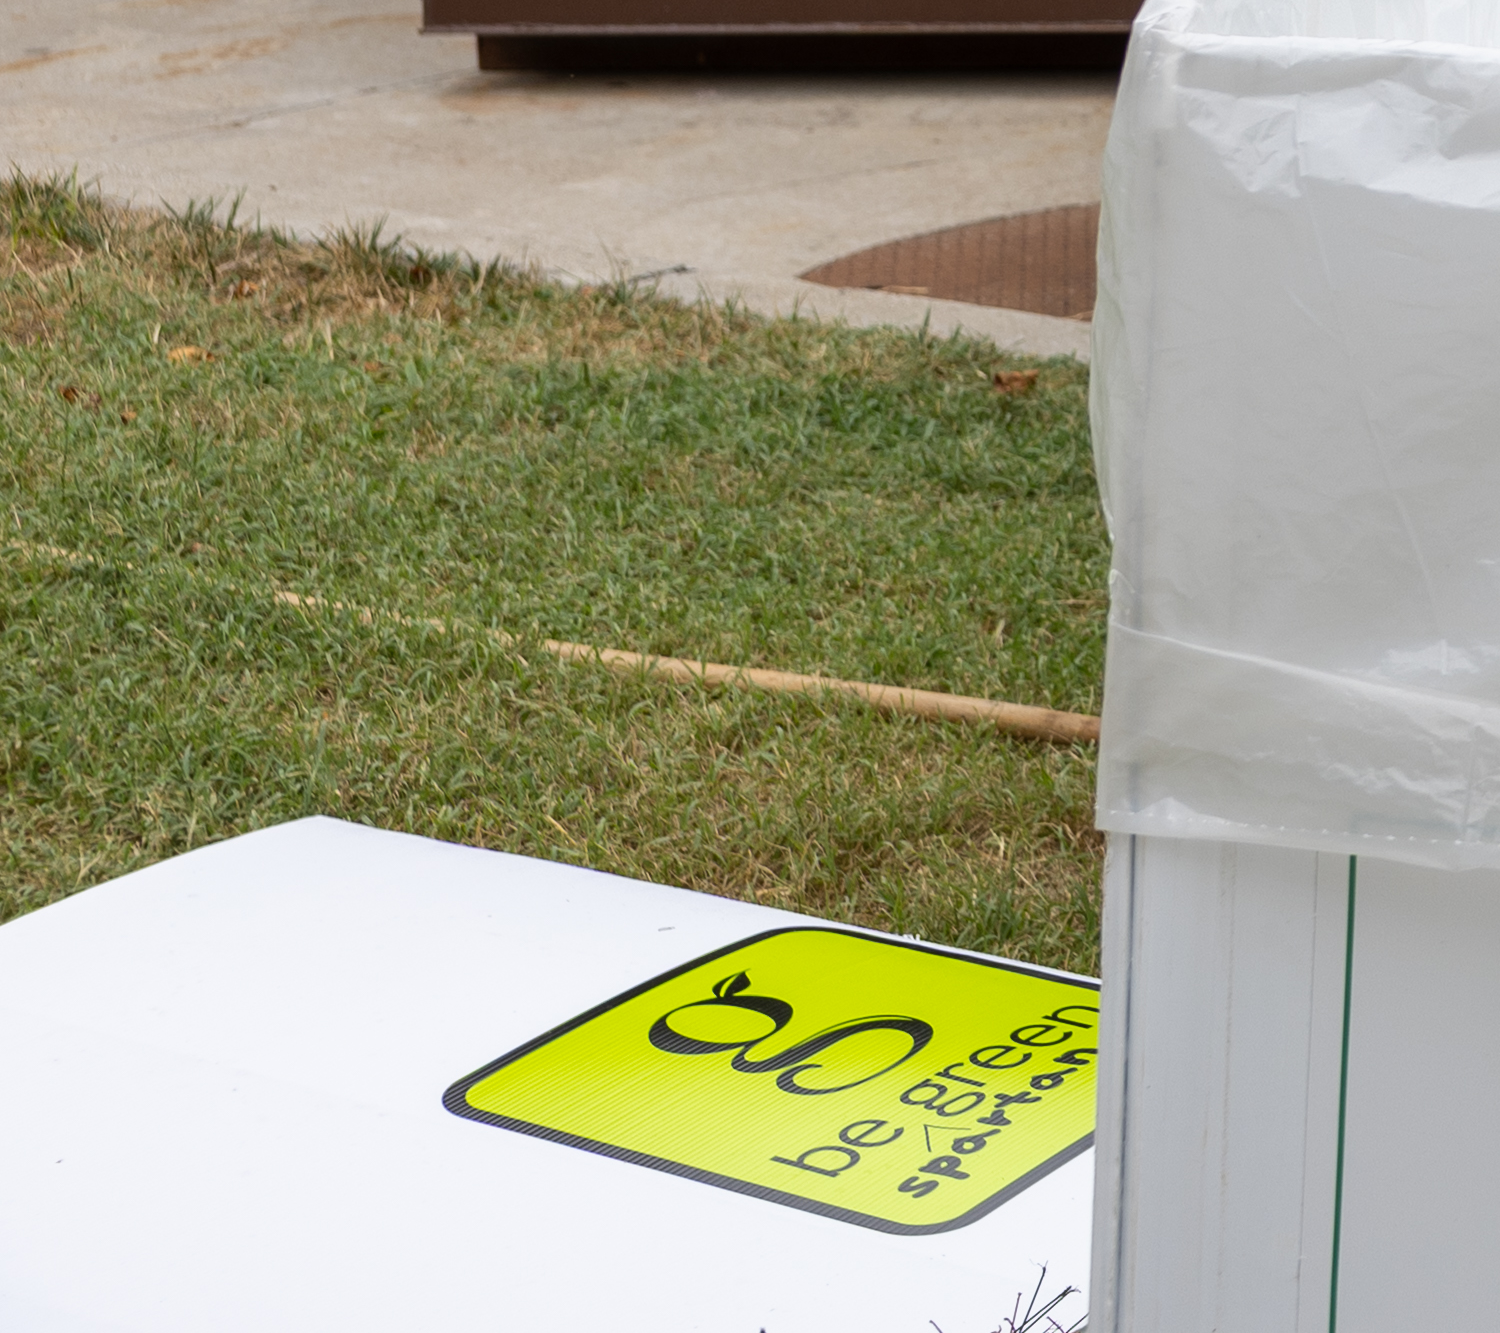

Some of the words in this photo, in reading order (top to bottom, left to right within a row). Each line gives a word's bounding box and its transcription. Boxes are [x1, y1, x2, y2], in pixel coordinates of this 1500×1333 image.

[770, 1119, 904, 1178] be
[899, 1005, 1100, 1117] green
[897, 1048, 1099, 1198] spartan
